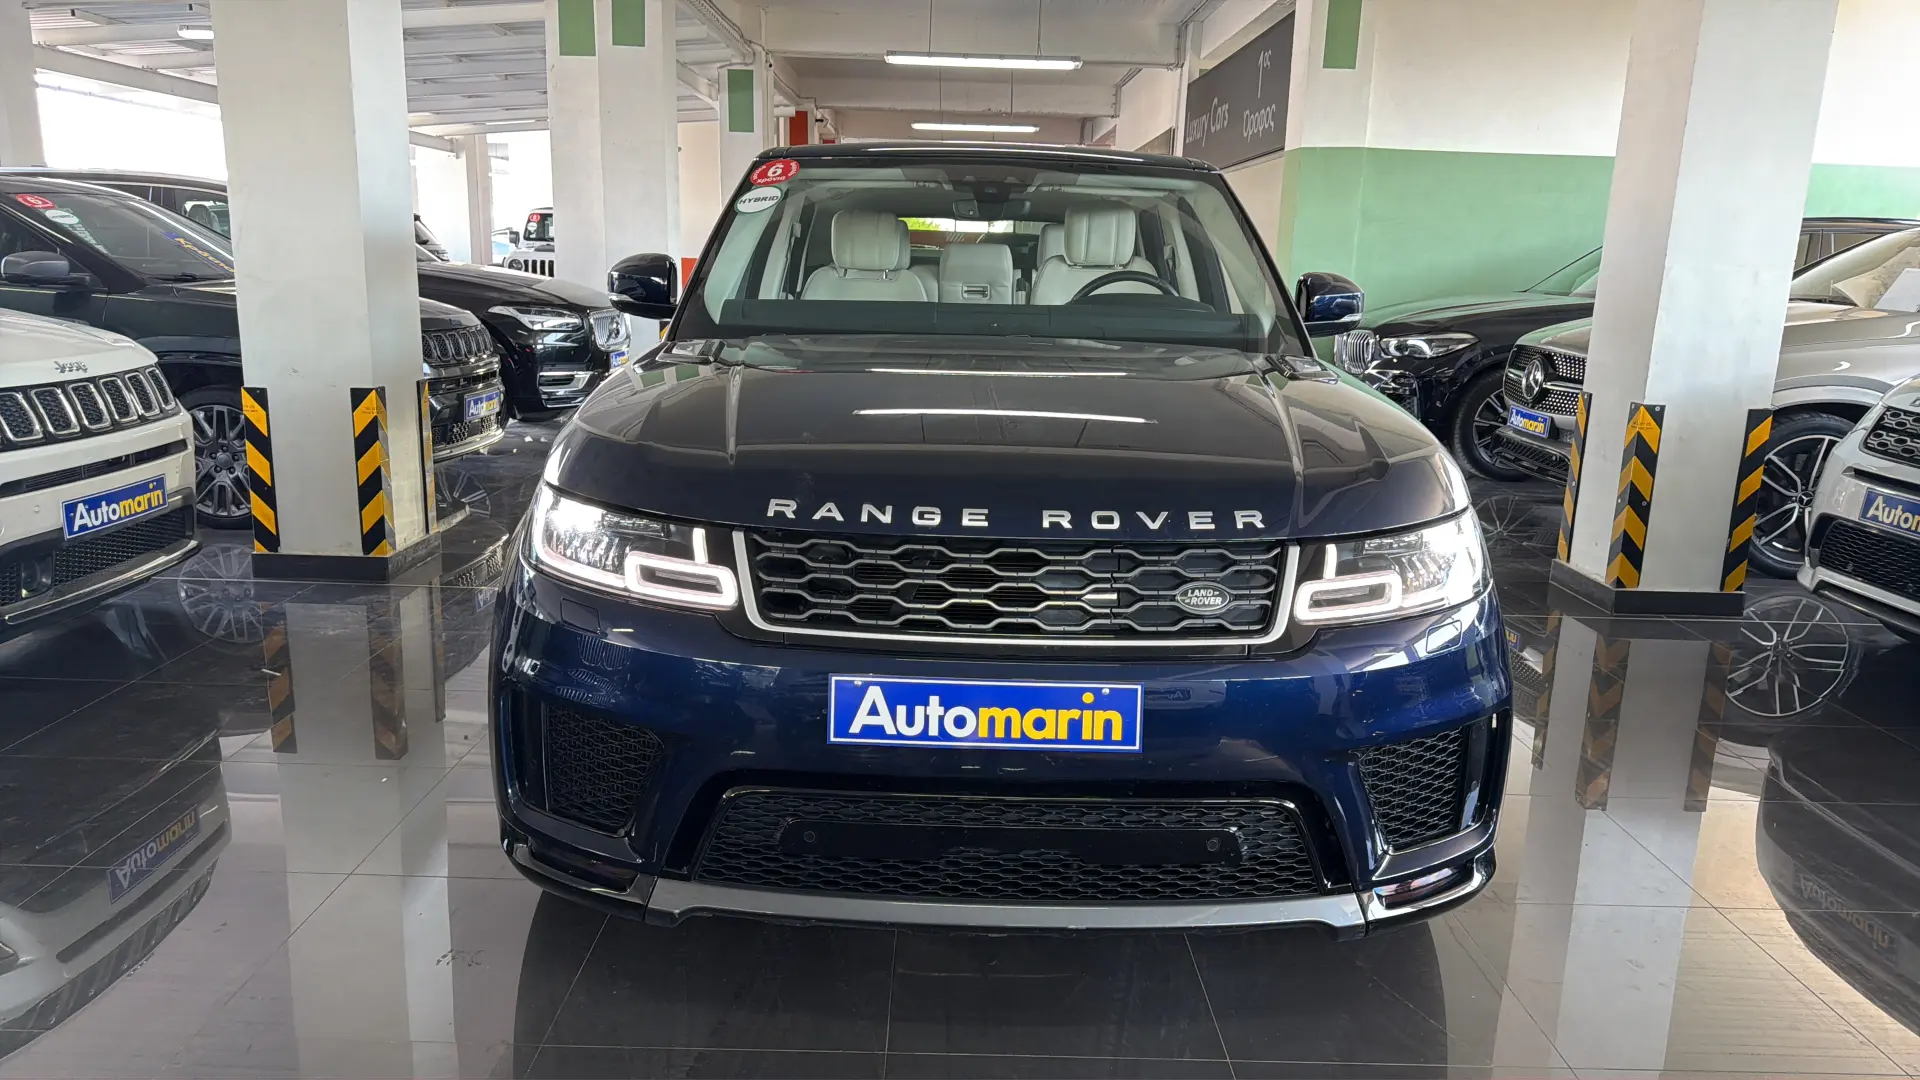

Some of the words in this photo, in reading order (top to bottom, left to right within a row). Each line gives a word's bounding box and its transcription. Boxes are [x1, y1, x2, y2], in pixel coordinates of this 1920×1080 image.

[1185, 110, 1210, 147] Luxury
[1210, 97, 1229, 133] Cars
[767, 163, 784, 177] 6
[739, 195, 779, 205] HYBRID
[54, 360, 88, 373] Jeep
[1509, 408, 1545, 434] Automarin
[73, 482, 164, 532] Automarin
[766, 498, 989, 527] RANGE
[1042, 509, 1266, 530] ROVER
[1187, 589, 1214, 597] LAND
[1190, 596, 1223, 605] ROVER
[848, 685, 1123, 742] Automarin
